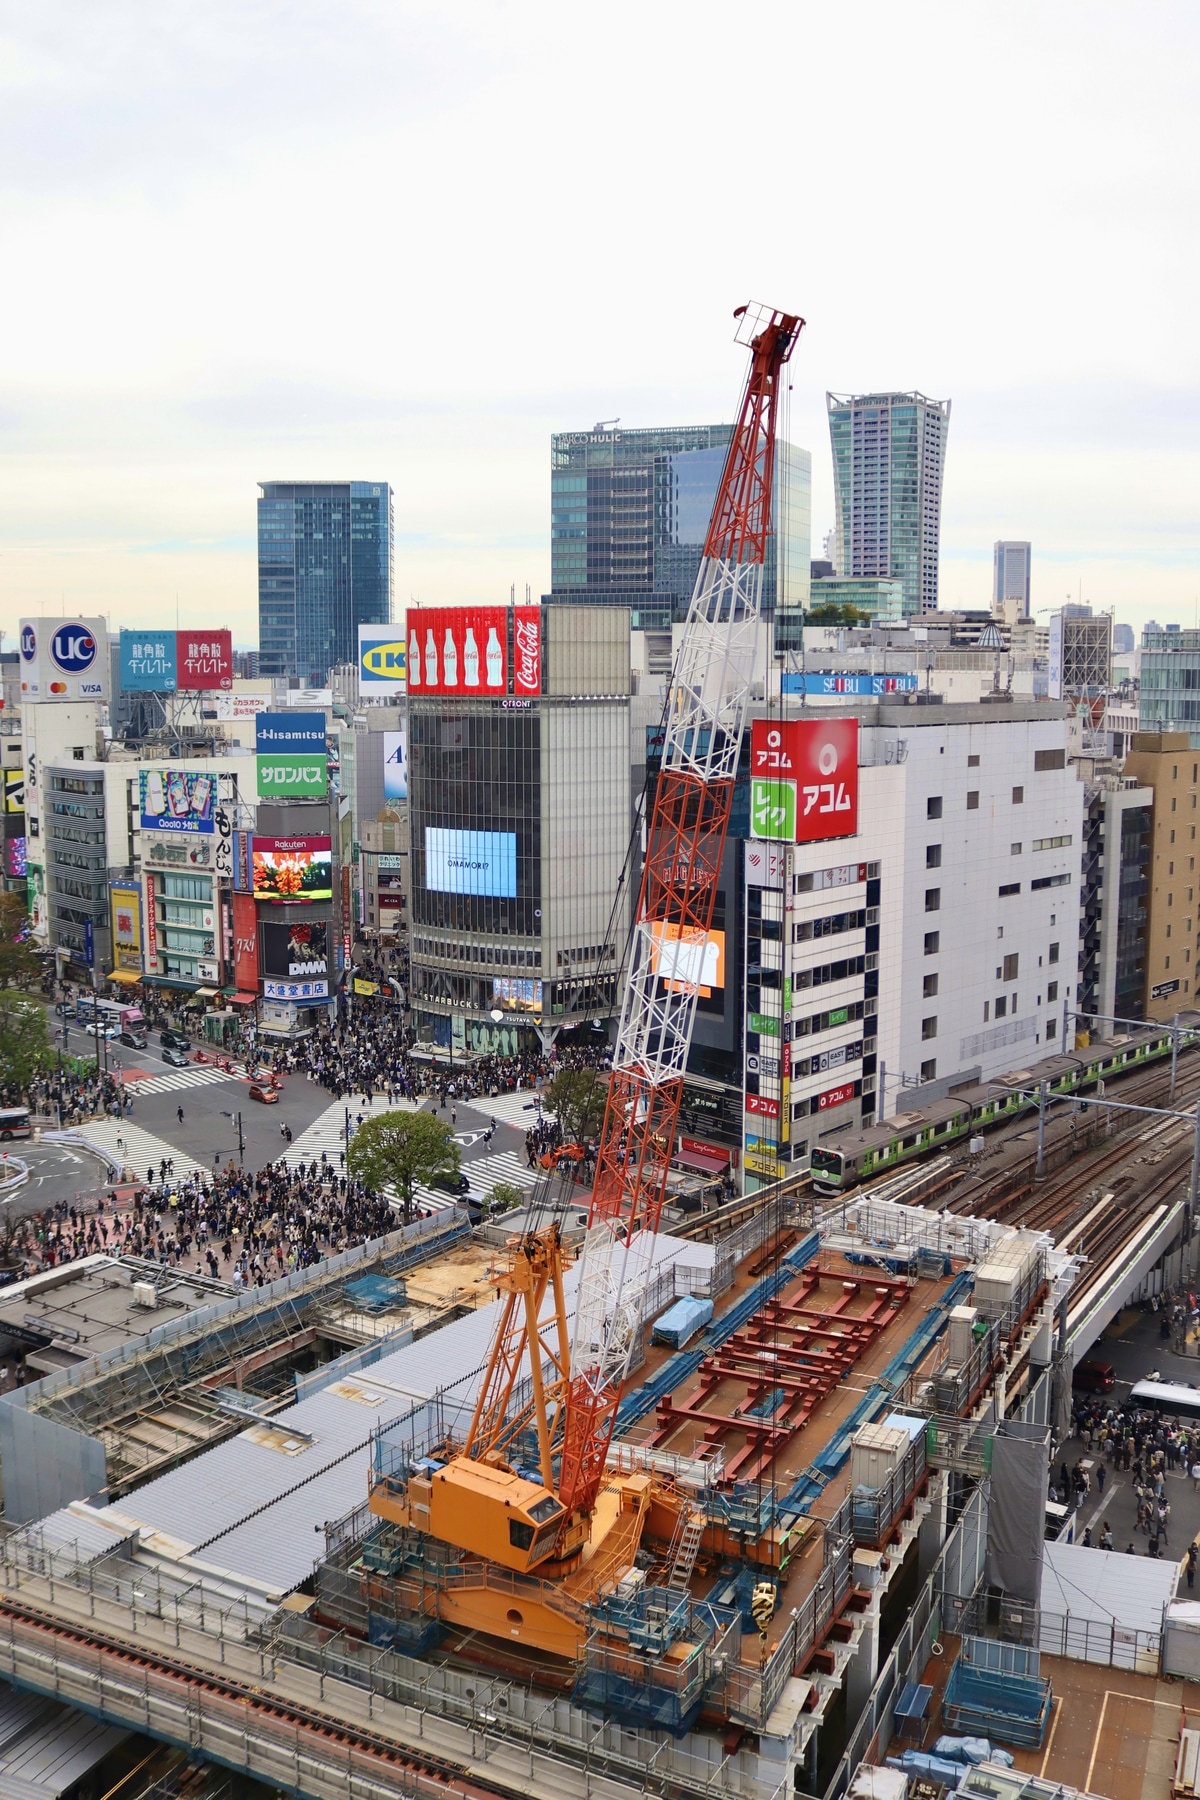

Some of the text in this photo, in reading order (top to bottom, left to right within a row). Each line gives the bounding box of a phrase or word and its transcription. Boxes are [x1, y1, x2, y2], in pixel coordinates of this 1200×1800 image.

[559, 434, 588, 445] PARCO
[590, 433, 621, 443] HULIC
[132, 643, 166, 658] 龍角散
[188, 643, 222, 658] 龍角散
[516, 618, 538, 689] Coca-Cola
[81, 684, 102, 693] VISA
[823, 678, 859, 693] SEIBU
[873, 678, 911, 693] SEIBU
[502, 700, 531, 708] QFRONT
[257, 728, 325, 740] Hisamitsu
[756, 751, 792, 768] アコム
[261, 766, 322, 784] サロンパス
[802, 782, 851, 816] アコム
[158, 819, 181, 829] Qoo10
[215, 808, 232, 876] もんじゃ
[274, 840, 307, 848] Rakuten
[447, 859, 489, 870] OMAMORI?
[237, 933, 256, 963] クスリ
[289, 960, 327, 976] DMM
[267, 983, 324, 996] 大盛堂書店
[557, 976, 616, 991] STARBUCKS
[424, 994, 479, 1010] STARBUCKS
[831, 1012, 845, 1023] レイク
[828, 1091, 844, 1104] アコム
[750, 1098, 777, 1114] アコム
[751, 1160, 777, 1174] プロミス
